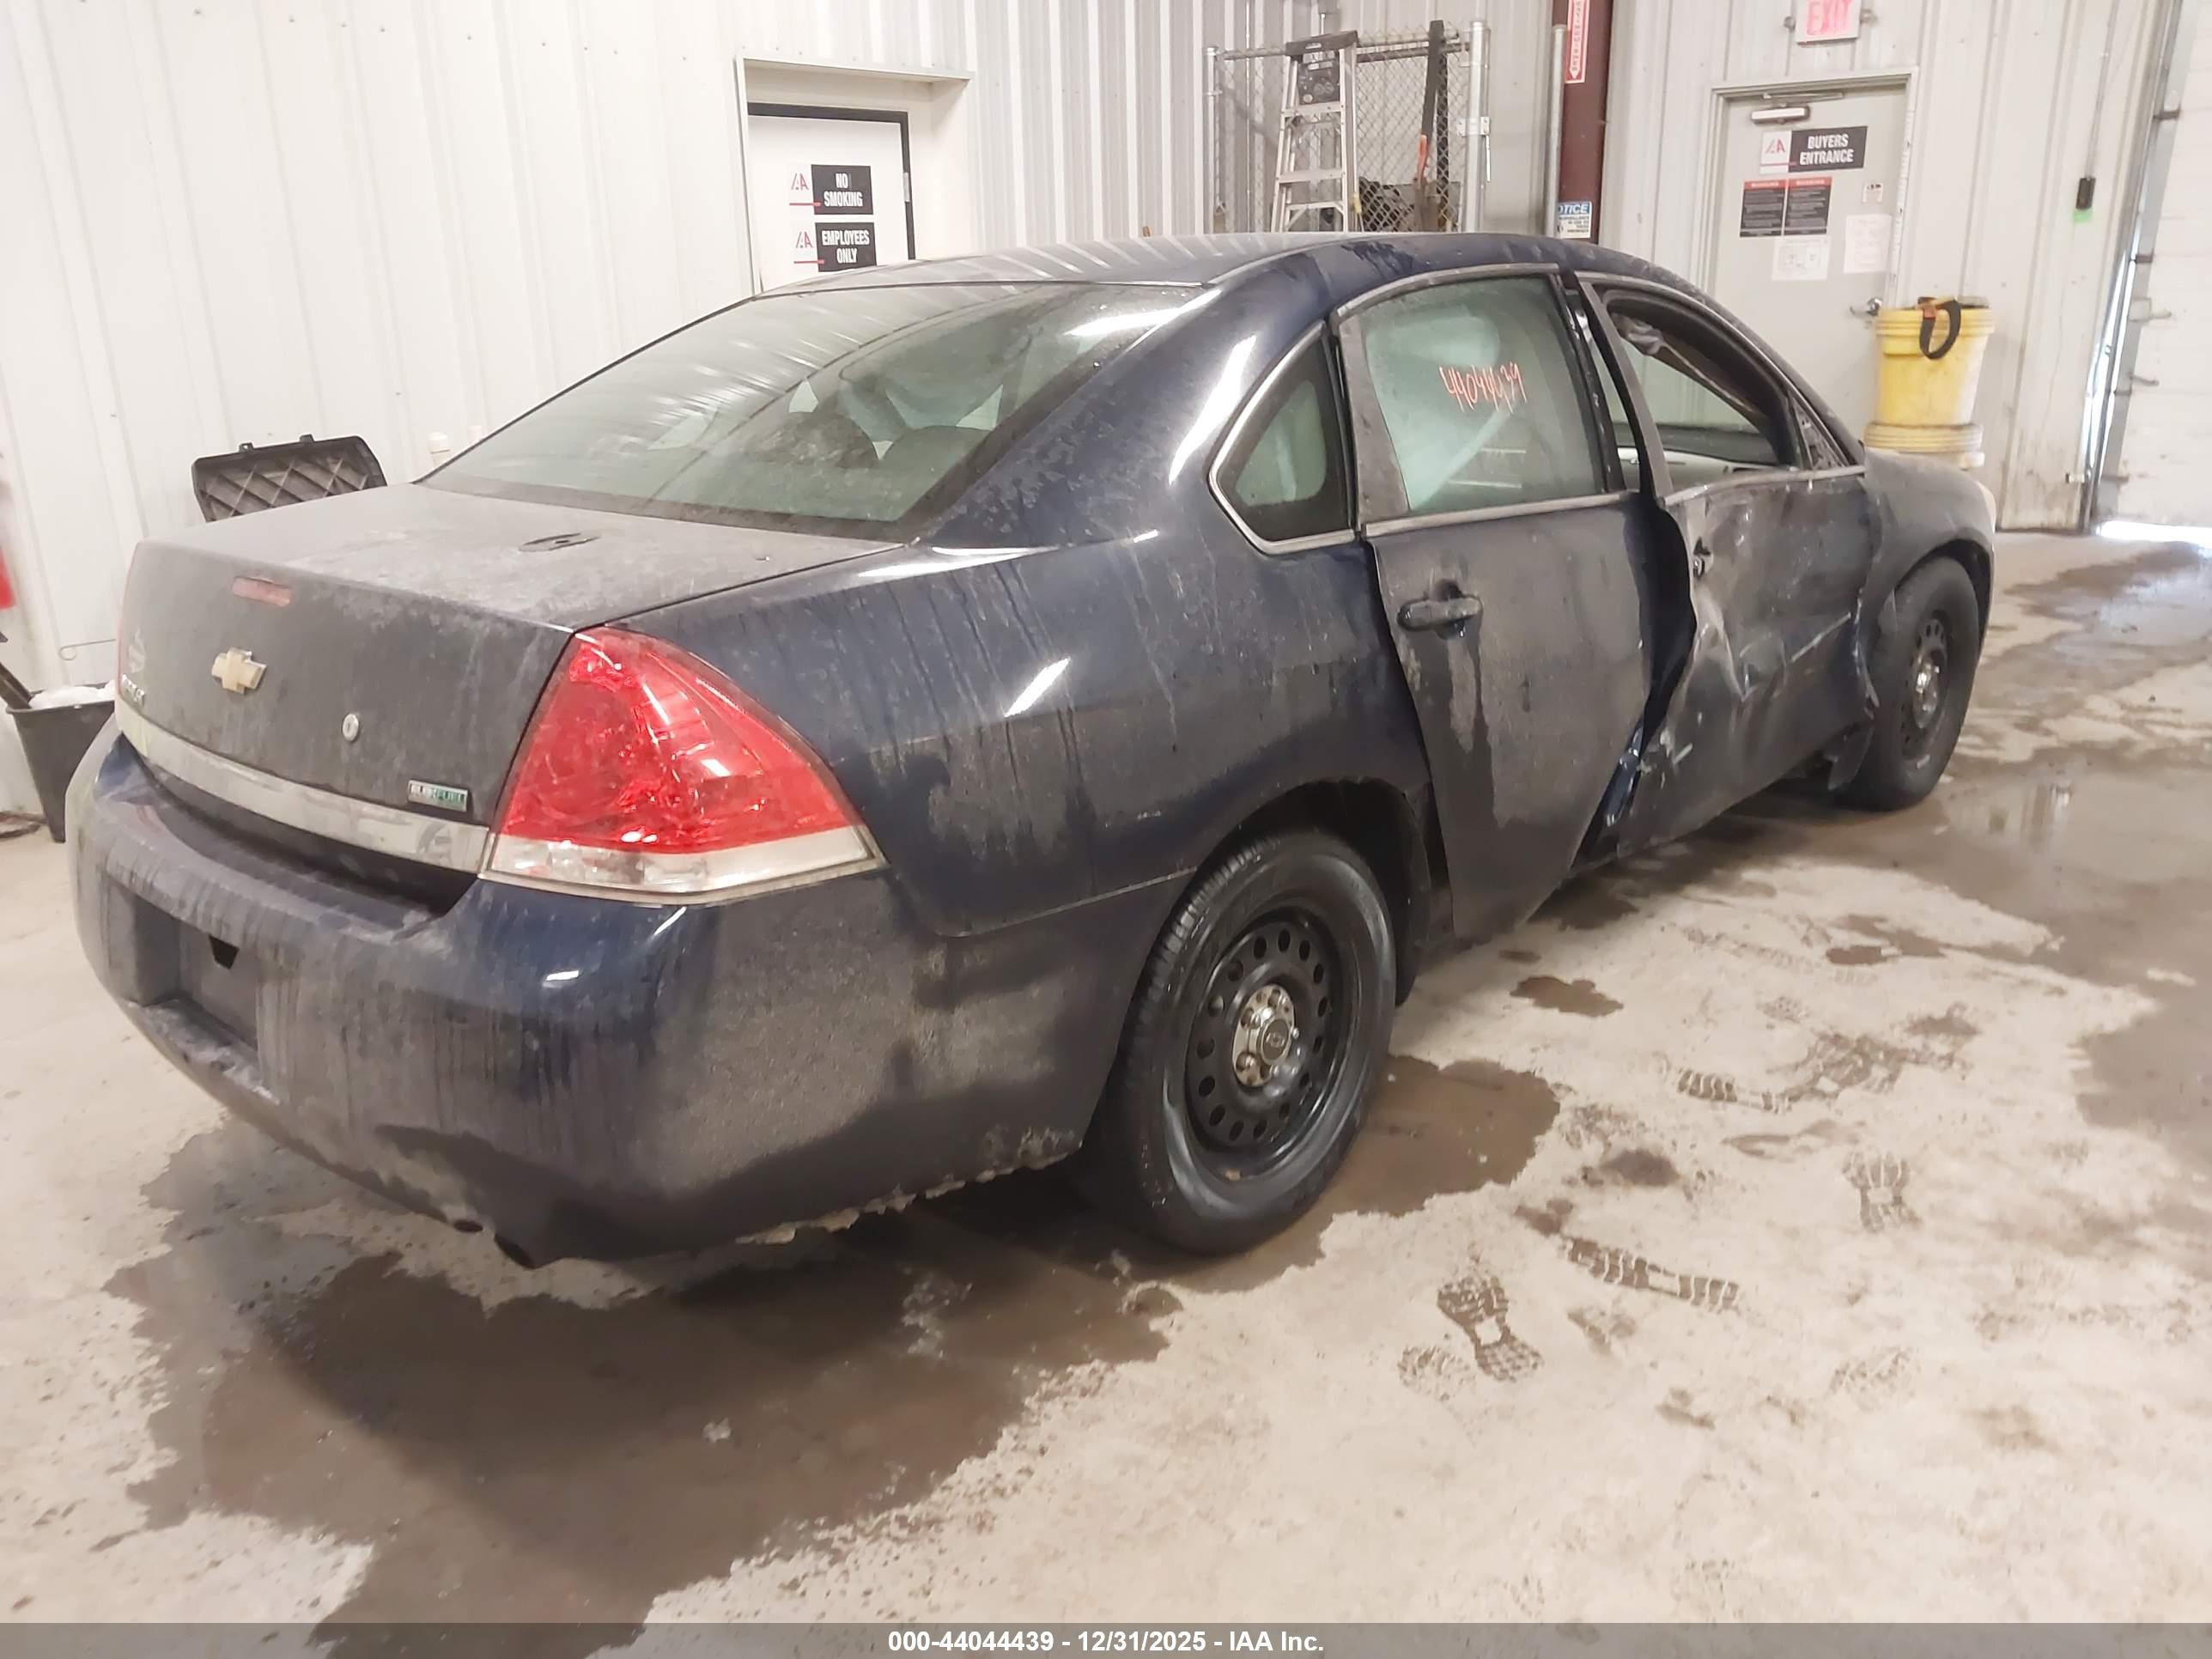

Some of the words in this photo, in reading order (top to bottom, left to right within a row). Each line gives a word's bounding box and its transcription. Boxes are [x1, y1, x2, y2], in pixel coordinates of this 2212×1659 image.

[1808, 133, 1849, 149] BUYERS
[1799, 149, 1855, 165] ENTRANCE
[835, 173, 848, 188] NO
[823, 191, 863, 207] SMOKING
[821, 229, 870, 246] EMPLOYEES
[836, 247, 858, 264] ONLY
